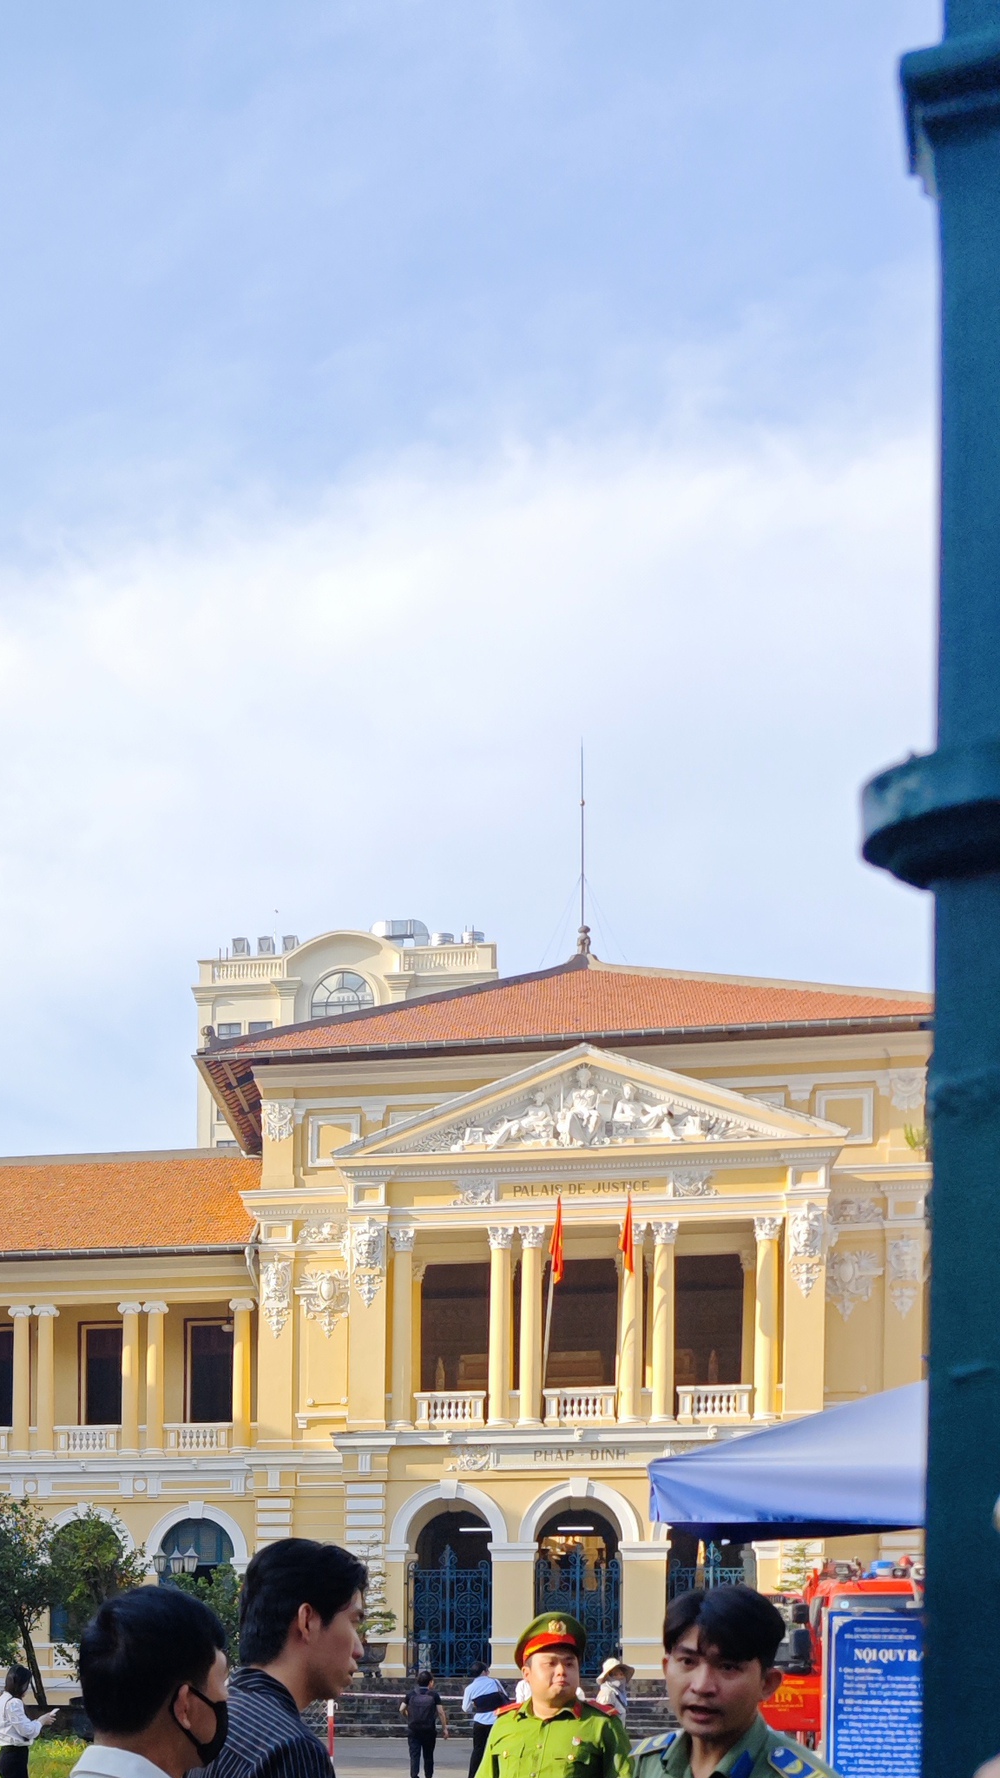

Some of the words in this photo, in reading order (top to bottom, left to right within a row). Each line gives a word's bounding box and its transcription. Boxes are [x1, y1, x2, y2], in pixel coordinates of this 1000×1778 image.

[513, 1184, 563, 1197] PALAIS
[569, 1183, 585, 1194] DE
[592, 1180, 650, 1194] JUSTICE
[854, 1647, 877, 1664] NỘI
[878, 1648, 907, 1664] QUY
